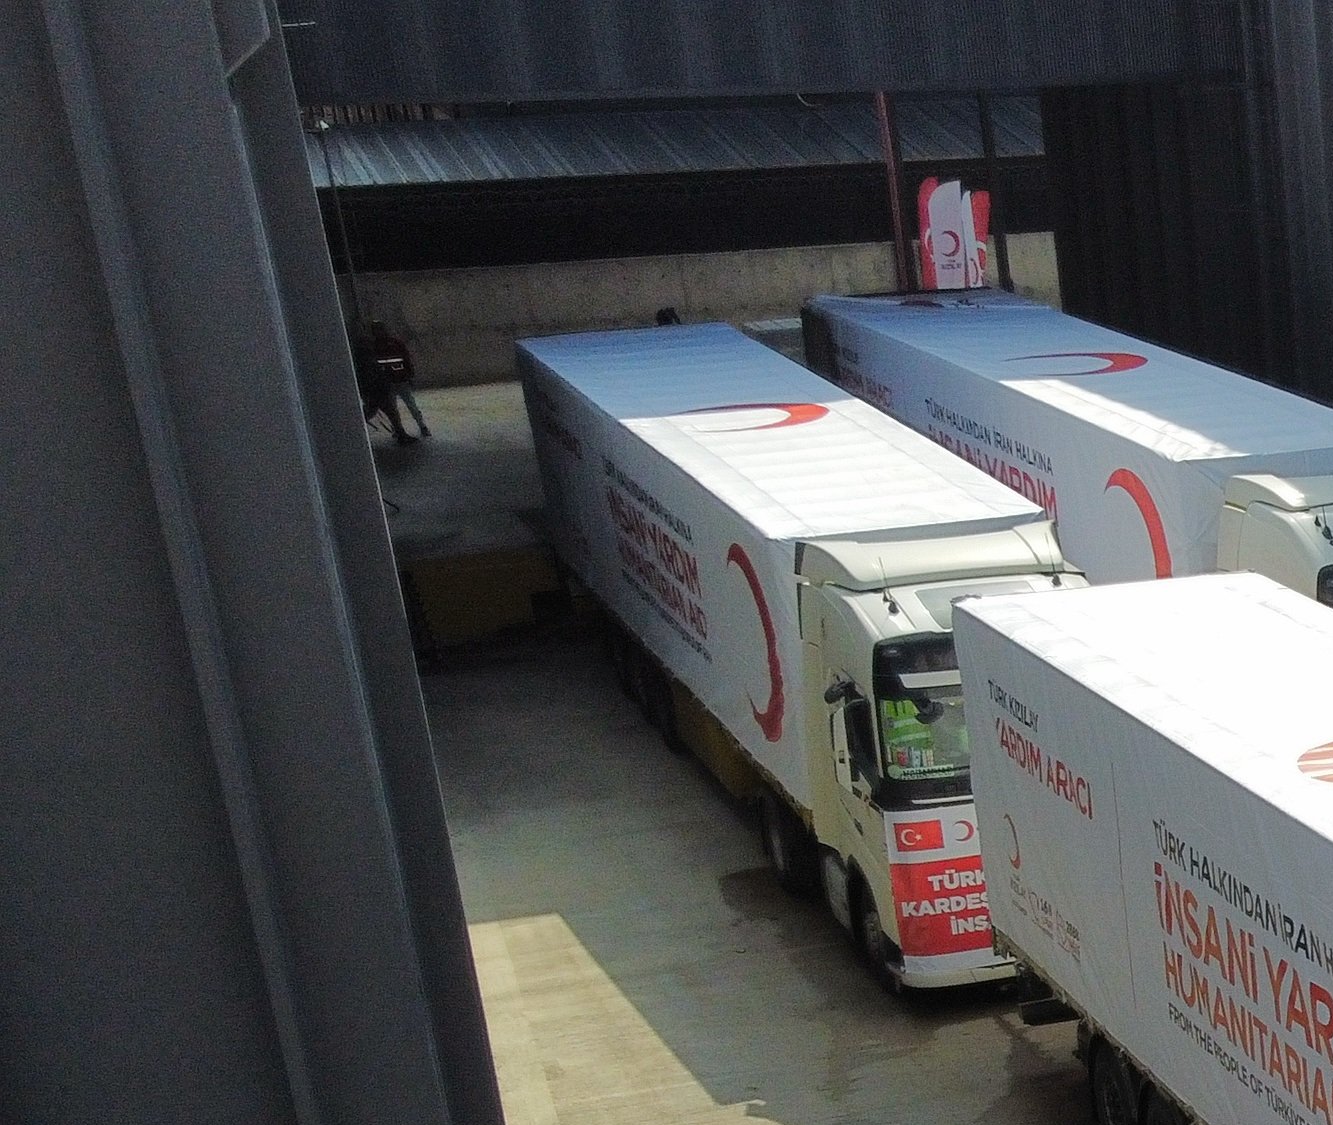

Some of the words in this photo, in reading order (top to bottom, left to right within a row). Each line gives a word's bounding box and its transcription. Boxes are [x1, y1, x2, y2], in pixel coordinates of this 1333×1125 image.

[1046, 755, 1093, 820] ARACI
[949, 915, 992, 936] İNS
[1152, 819, 1186, 872] TÜRK
[1190, 846, 1278, 937] HALKINDAN
[1278, 903, 1322, 967] İRAN
[1154, 862, 1258, 1005] İNSANİ
[1168, 1002, 1194, 1038] FROM
[1194, 1025, 1214, 1054] THE
[1213, 1041, 1249, 1088] PEOPLE
[1250, 1077, 1263, 1098] OF
